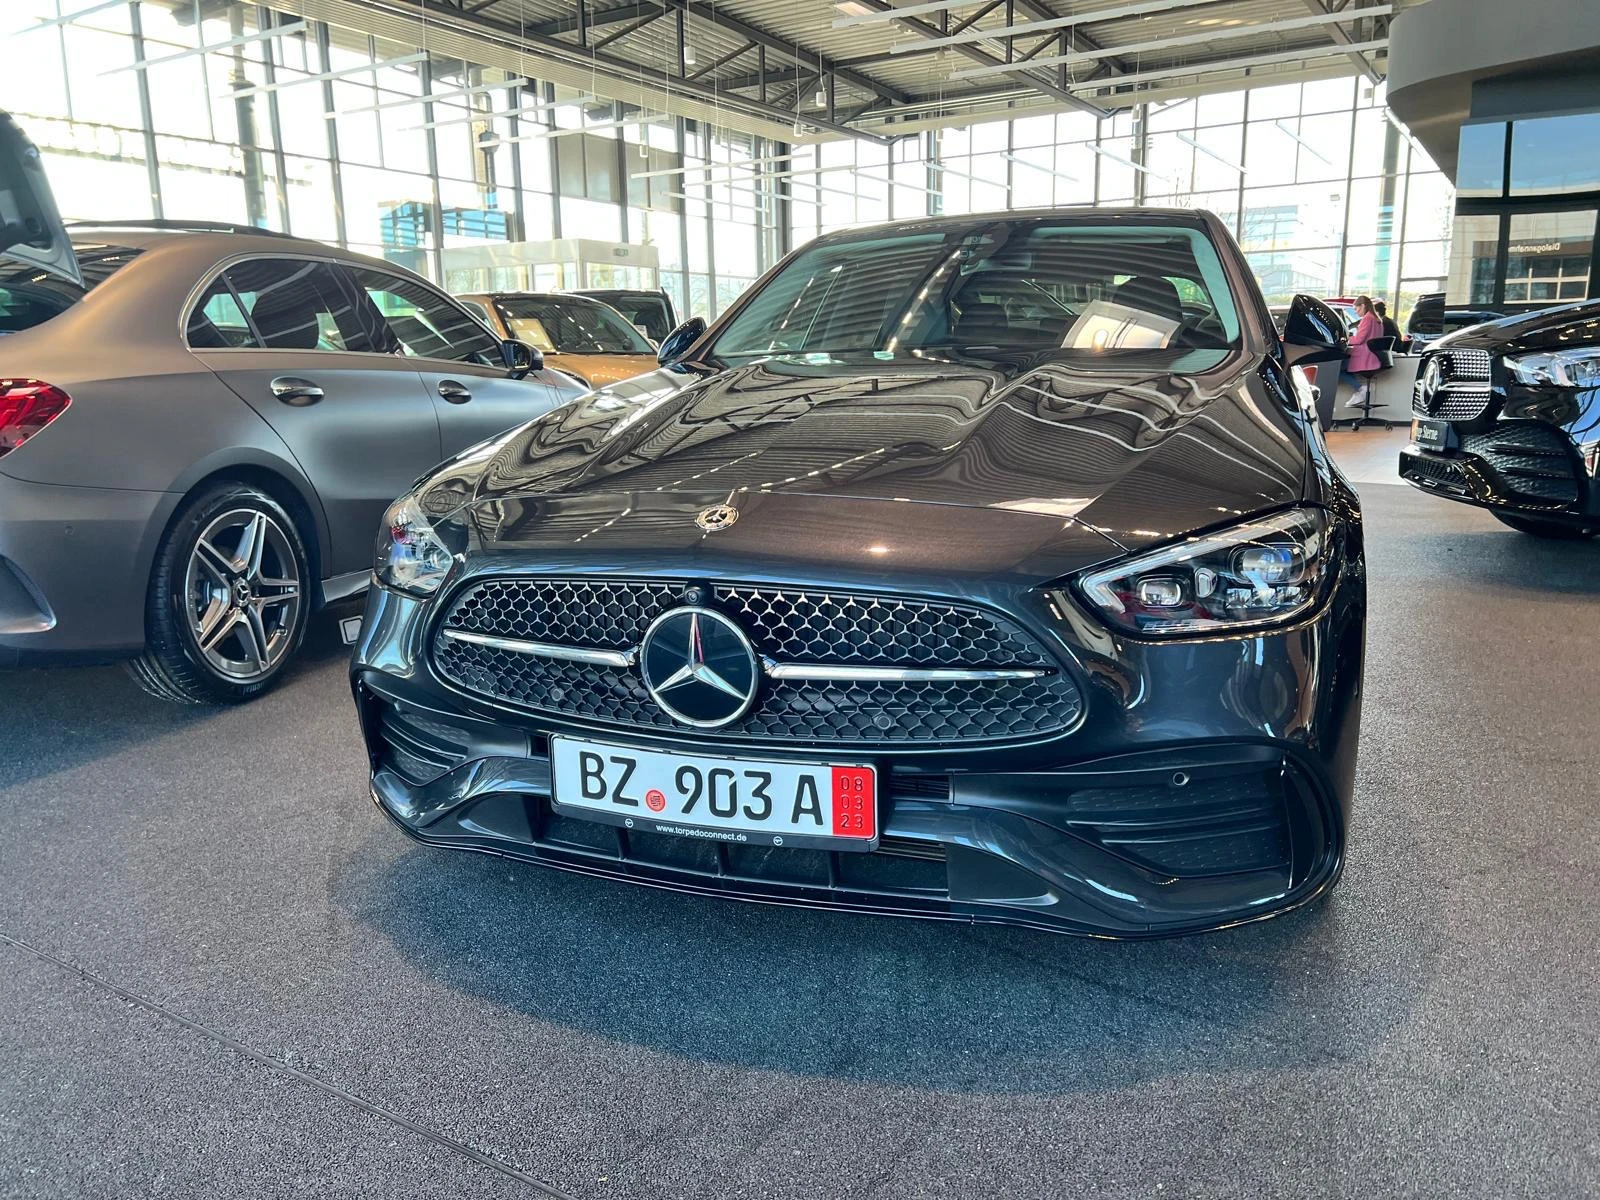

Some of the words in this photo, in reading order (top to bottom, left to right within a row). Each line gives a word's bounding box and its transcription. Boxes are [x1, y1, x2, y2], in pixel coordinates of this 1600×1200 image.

[579, 751, 639, 807] BZ
[675, 765, 773, 821] 903
[791, 775, 823, 826] A
[841, 775, 863, 792] 08
[841, 794, 863, 810] 03
[841, 813, 863, 828] 23
[656, 825, 747, 842] www.torpedoconnect.de
